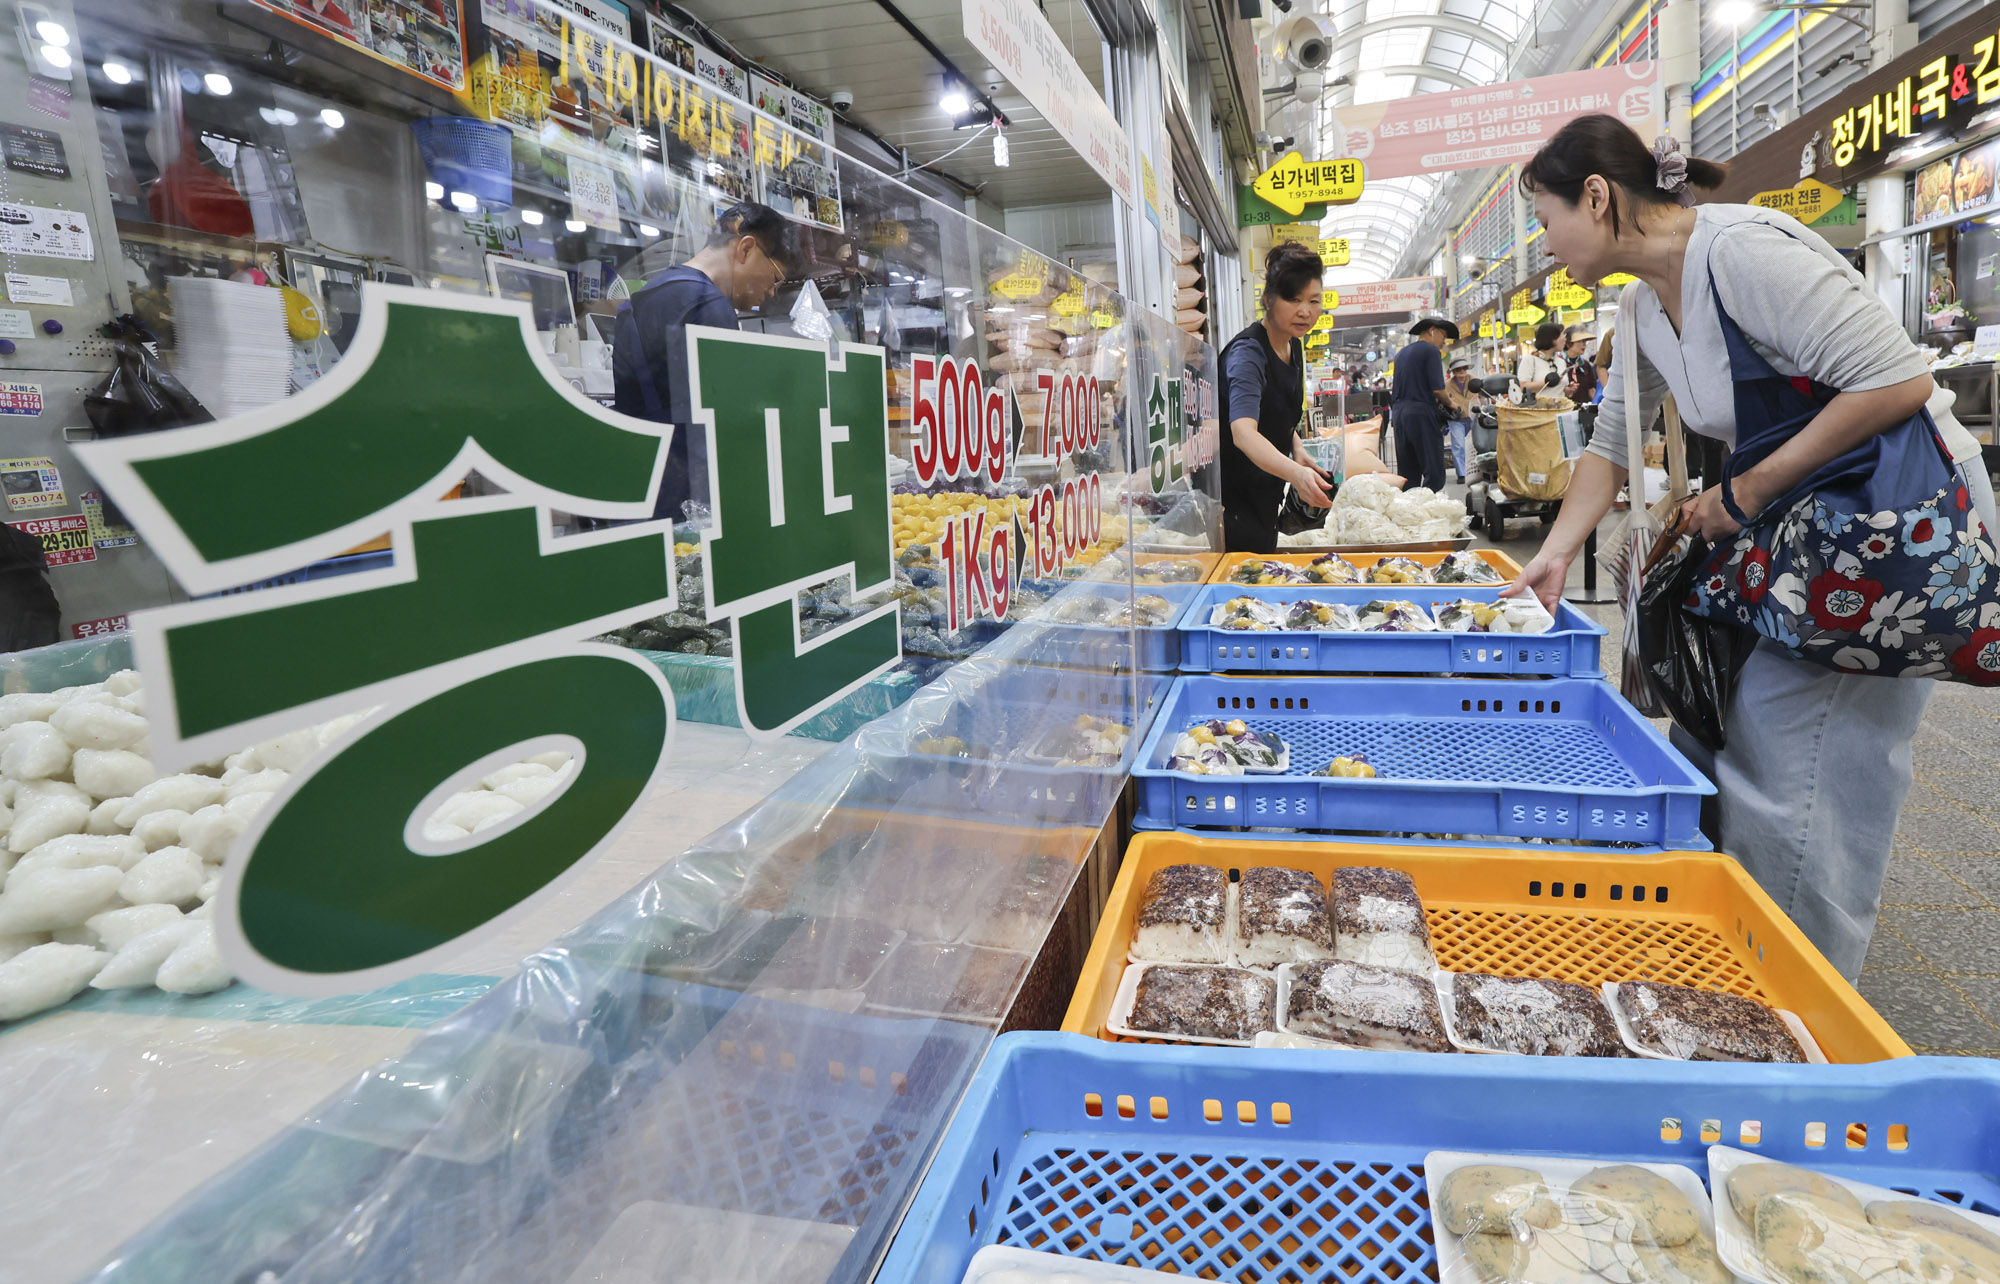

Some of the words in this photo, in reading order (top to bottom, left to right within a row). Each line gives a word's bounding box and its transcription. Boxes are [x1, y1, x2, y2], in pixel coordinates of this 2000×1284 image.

[980, 3, 1022, 79] 3,500원
[1270, 163, 1355, 190] 심가네떡집
[1288, 187, 1344, 199] T.957-8948
[1760, 193, 1794, 208] 쌍화차
[1798, 188, 1821, 204] 전문
[1244, 211, 1271, 223] 다-38
[1329, 239, 1347, 254] 고추
[9, 384, 38, 393] 서비스
[911, 354, 1005, 488] 500g
[1037, 369, 1100, 471] 7,000
[1148, 373, 1183, 497] 송편
[11, 493, 63, 506] 63-0074
[940, 507, 1010, 638] 1Kg
[1028, 471, 1101, 583] 13,000
[90, 285, 903, 990] 송편
